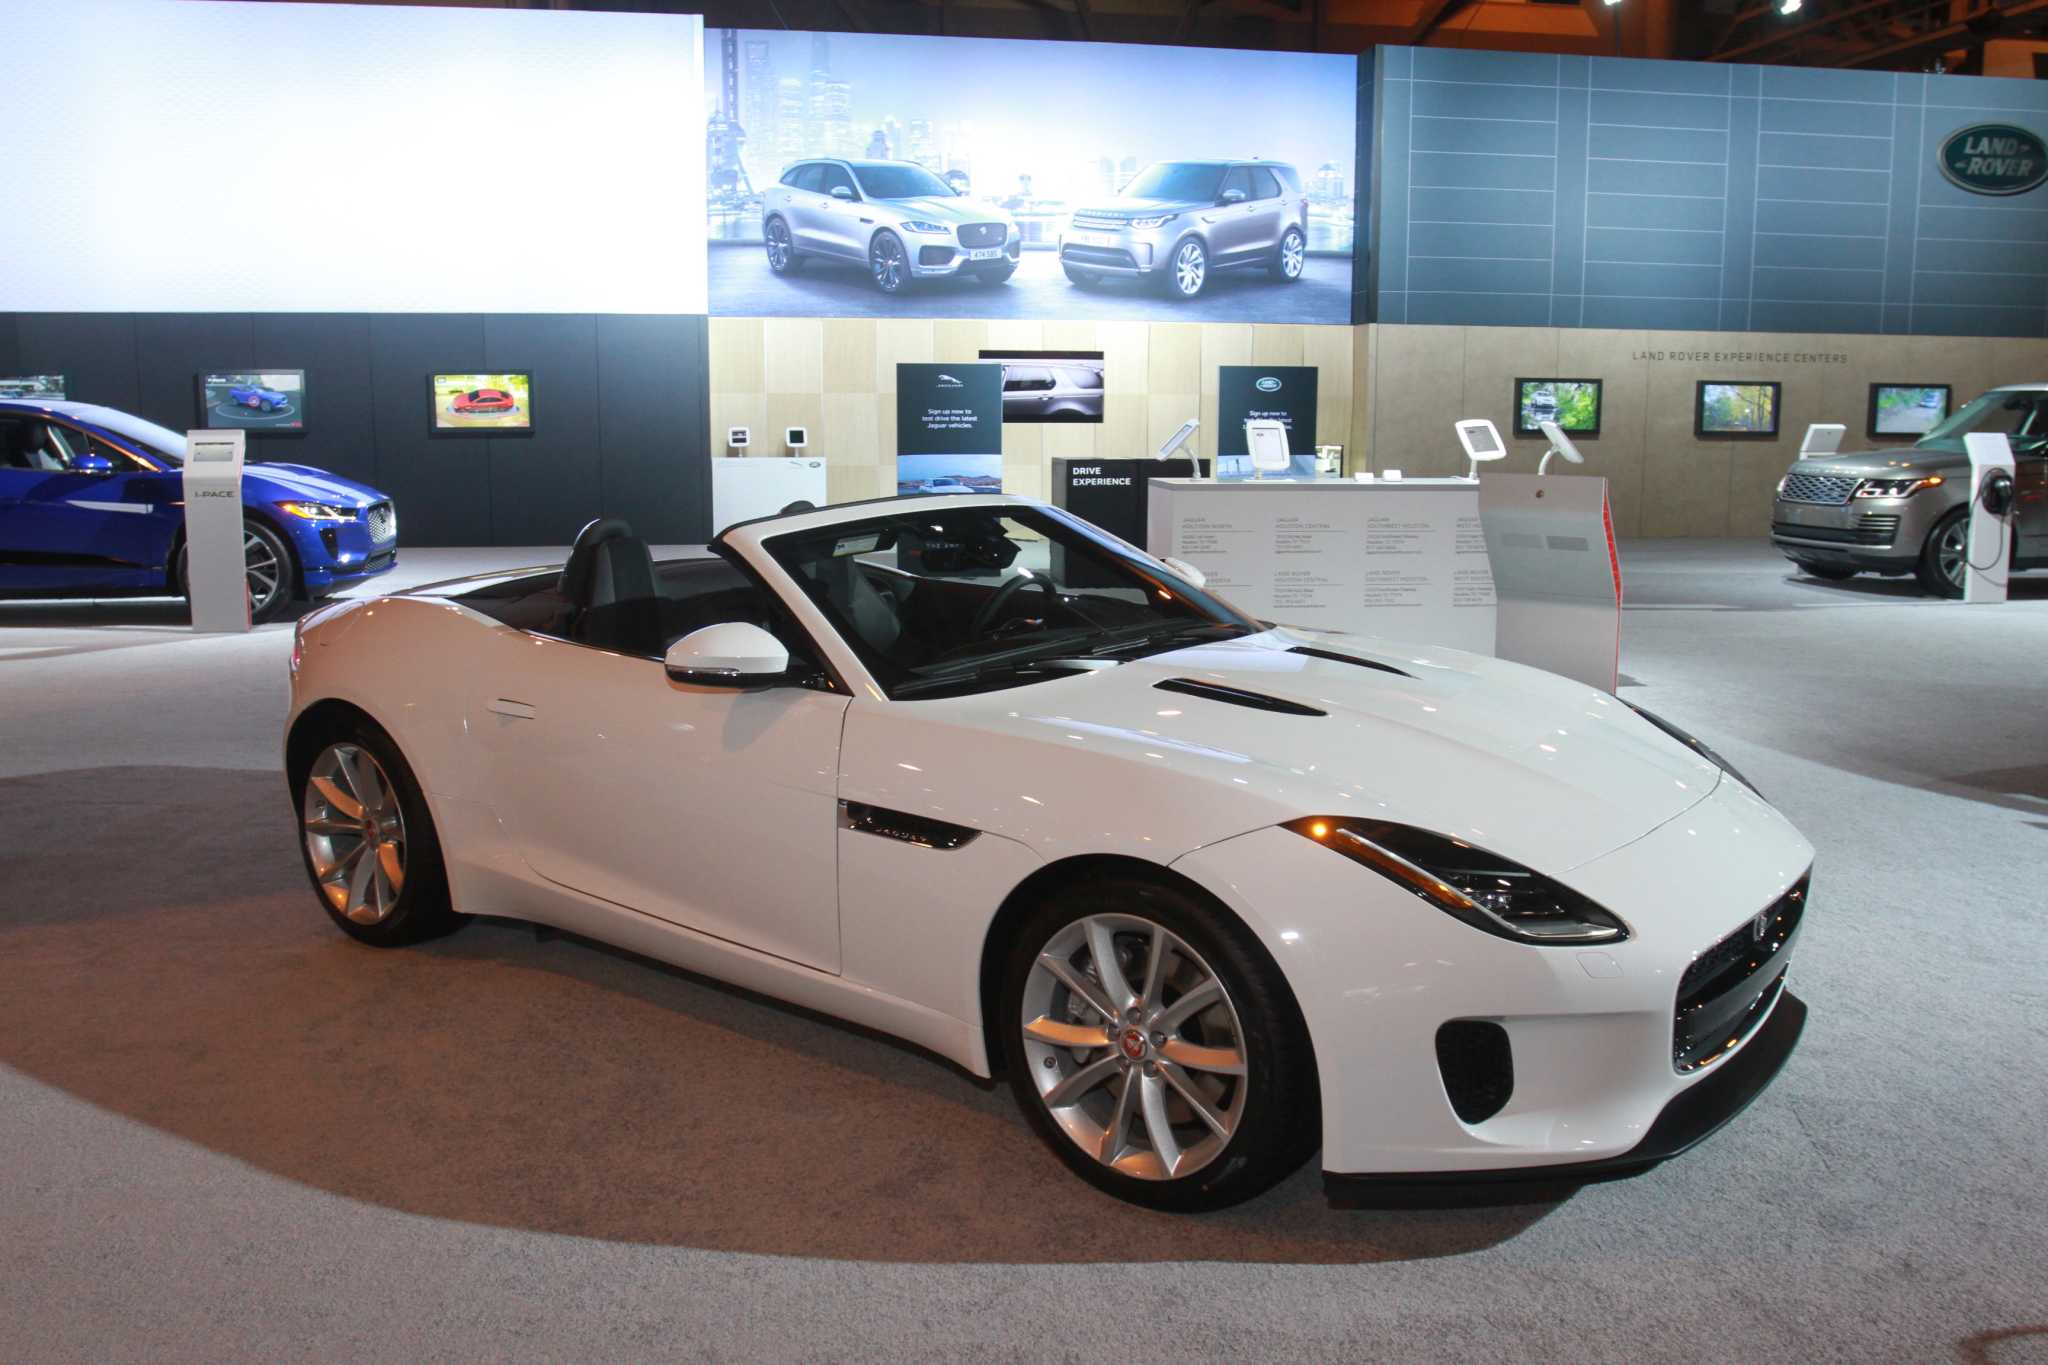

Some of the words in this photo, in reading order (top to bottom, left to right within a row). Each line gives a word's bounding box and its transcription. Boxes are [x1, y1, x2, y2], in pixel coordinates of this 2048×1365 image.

[1963, 136, 2018, 156] LAND
[1966, 156, 2033, 177] ROVER
[1632, 351, 1665, 361] LAND
[1669, 351, 1710, 362] ROVER
[1714, 352, 1788, 362] EXPERIENCE
[1792, 353, 1848, 364] CENTERS
[1249, 410, 1262, 418] Sign
[927, 422, 948, 430] Jaguar
[1072, 467, 1102, 475] DRIVE
[1072, 478, 1132, 486] EXPERIENCE
[194, 490, 235, 498] I-PACE
